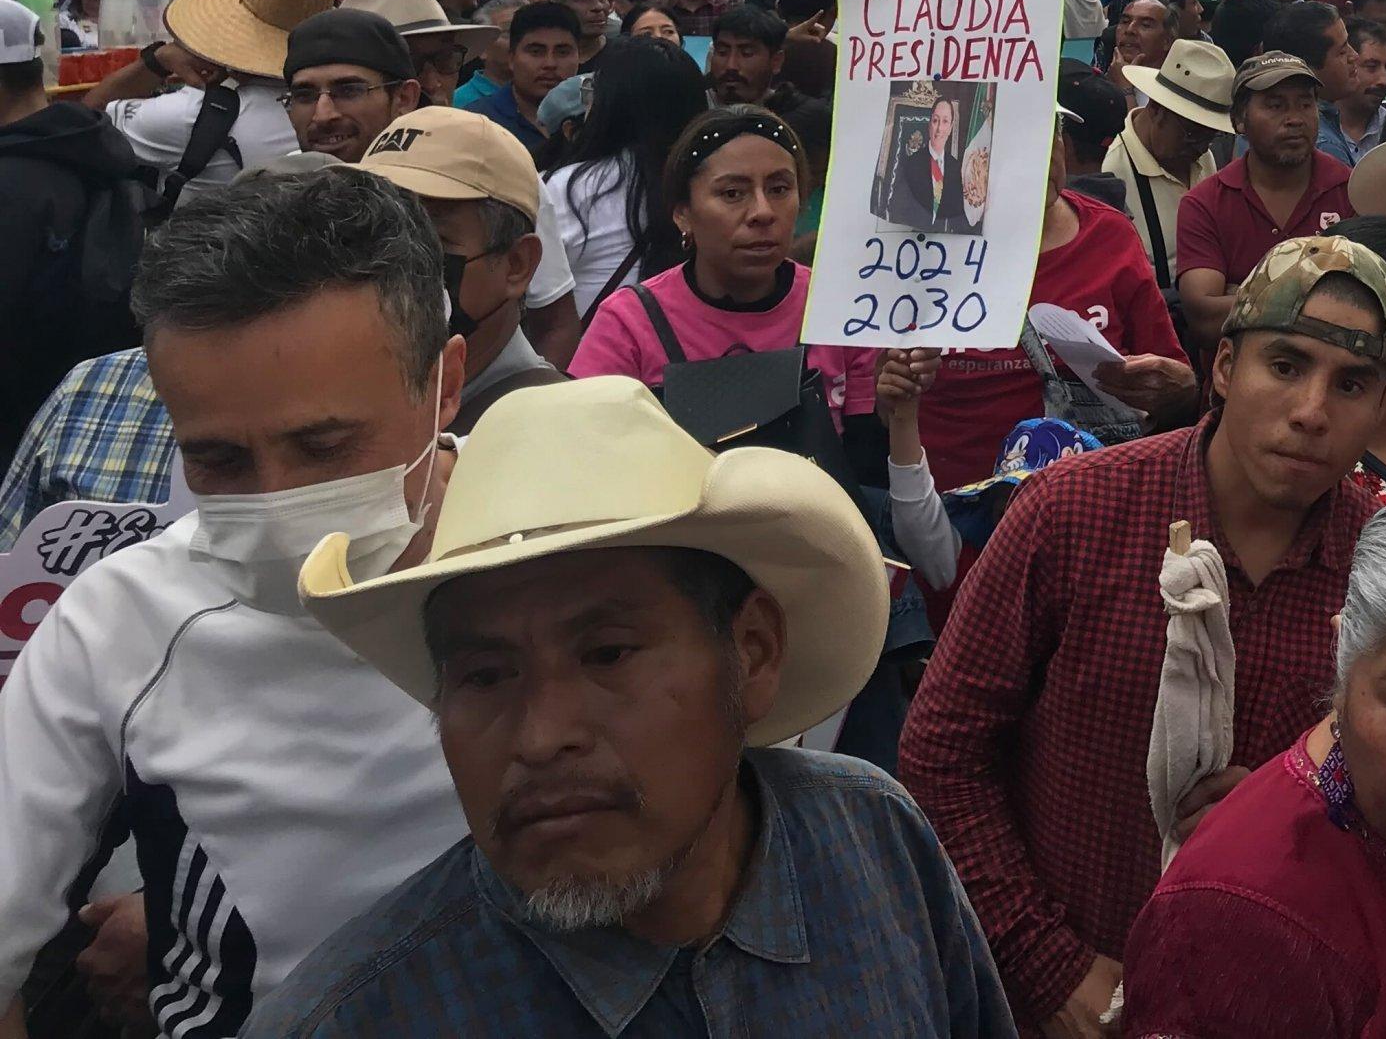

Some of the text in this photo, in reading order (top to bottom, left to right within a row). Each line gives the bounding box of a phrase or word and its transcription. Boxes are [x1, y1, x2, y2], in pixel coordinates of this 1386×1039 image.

[367, 127, 424, 157] CAT
[858, 237, 988, 283] 2024
[843, 288, 987, 337] 2030
[948, 357, 1032, 374] esperanza
